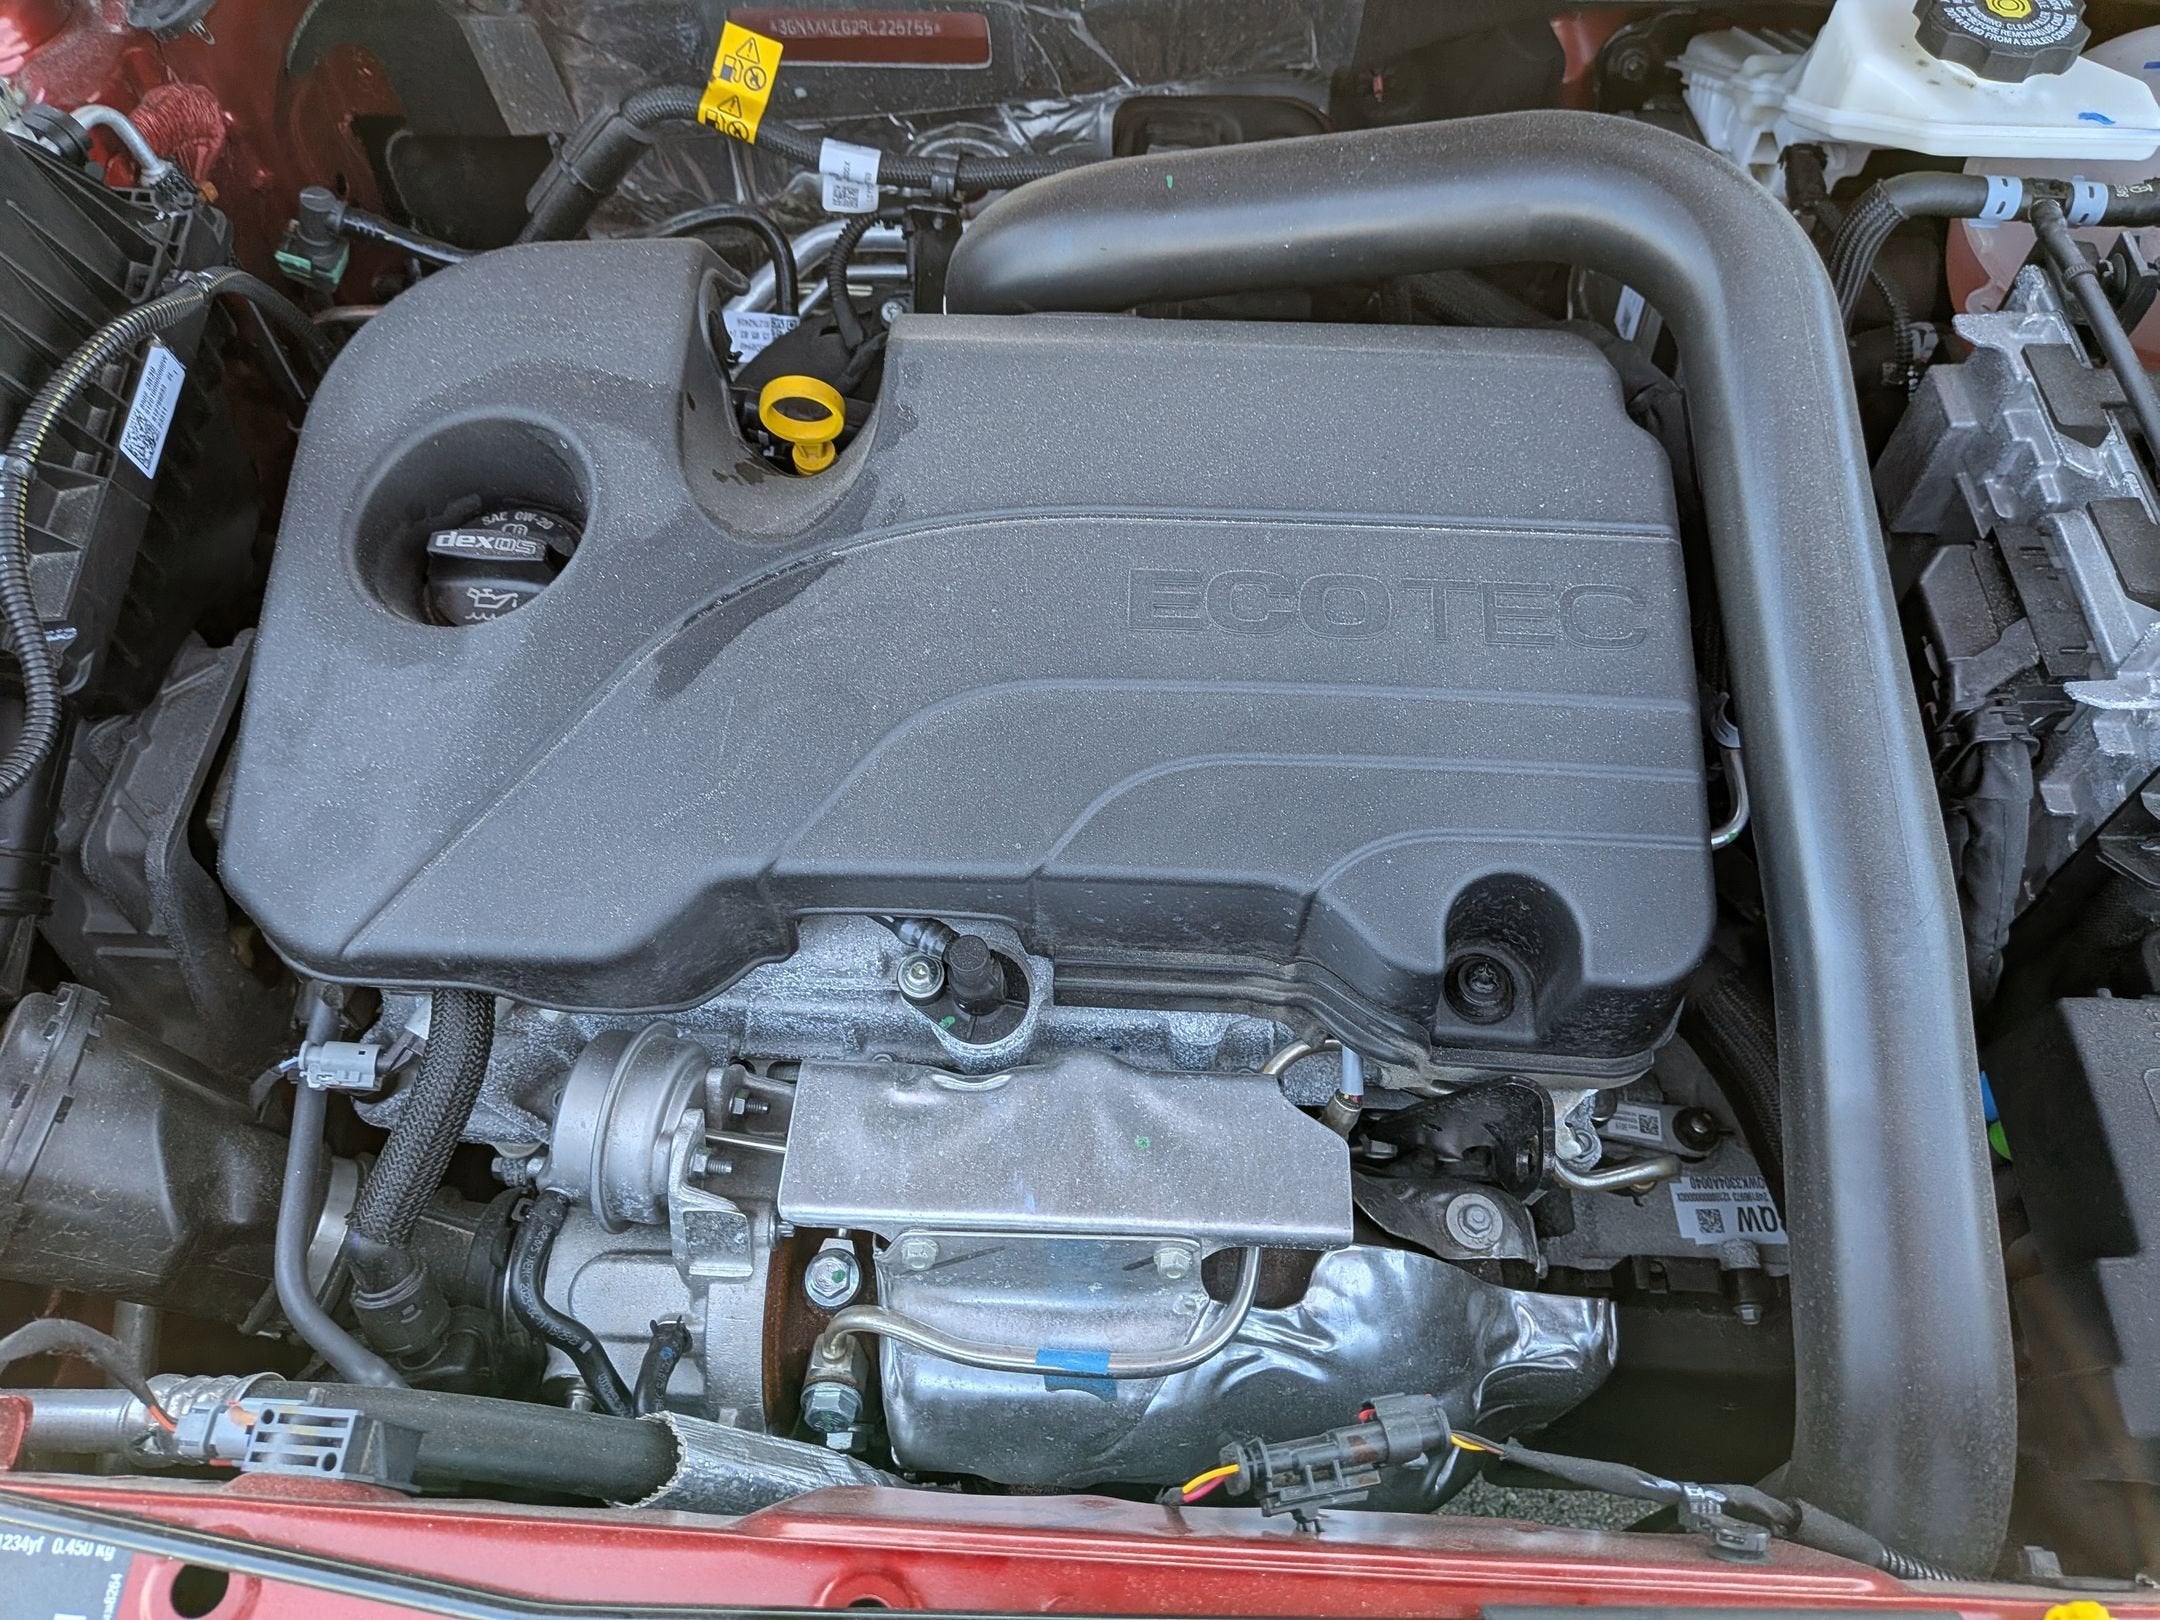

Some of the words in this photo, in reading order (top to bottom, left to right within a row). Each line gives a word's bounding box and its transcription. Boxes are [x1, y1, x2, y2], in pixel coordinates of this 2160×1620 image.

[1984, 32, 2012, 44] FROM
[2013, 36, 2021, 46] A
[2021, 35, 2055, 46] SEALED
[481, 511, 508, 526] SAE
[435, 531, 538, 555] dexos
[1128, 567, 1648, 651] ECOTEC
[1737, 1205, 1785, 1232] QW
[51, 1537, 95, 1557] 0.450
[95, 1543, 116, 1561] kg
